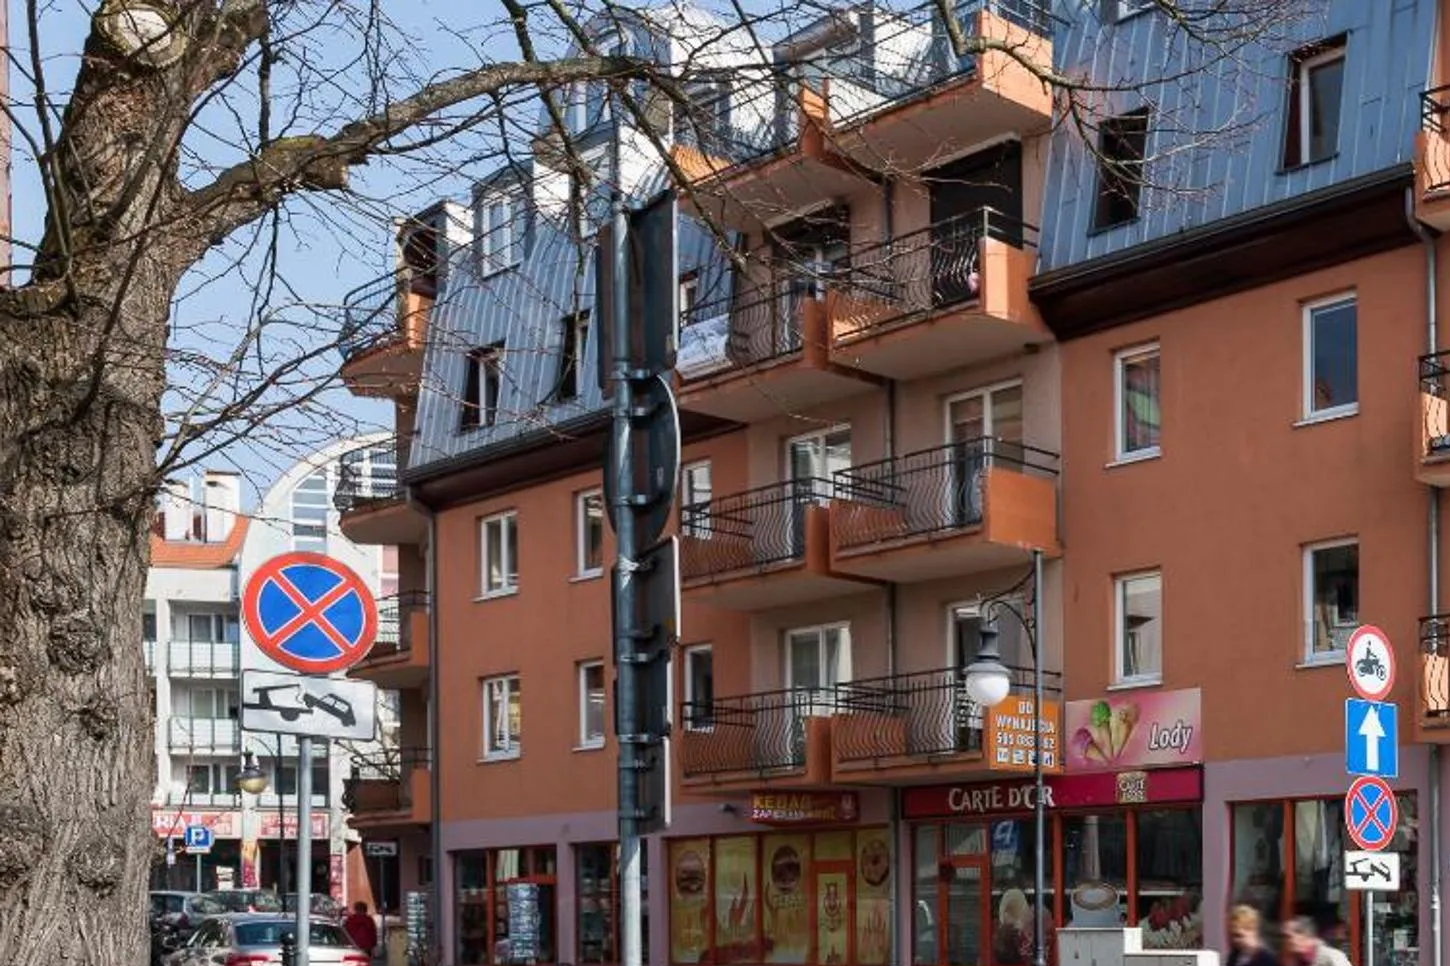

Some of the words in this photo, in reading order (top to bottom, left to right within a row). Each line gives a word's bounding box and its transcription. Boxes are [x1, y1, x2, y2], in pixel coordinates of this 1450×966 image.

[1149, 720, 1192, 753] Lody
[950, 787, 1003, 813] CARTE
[191, 828, 205, 846] P
